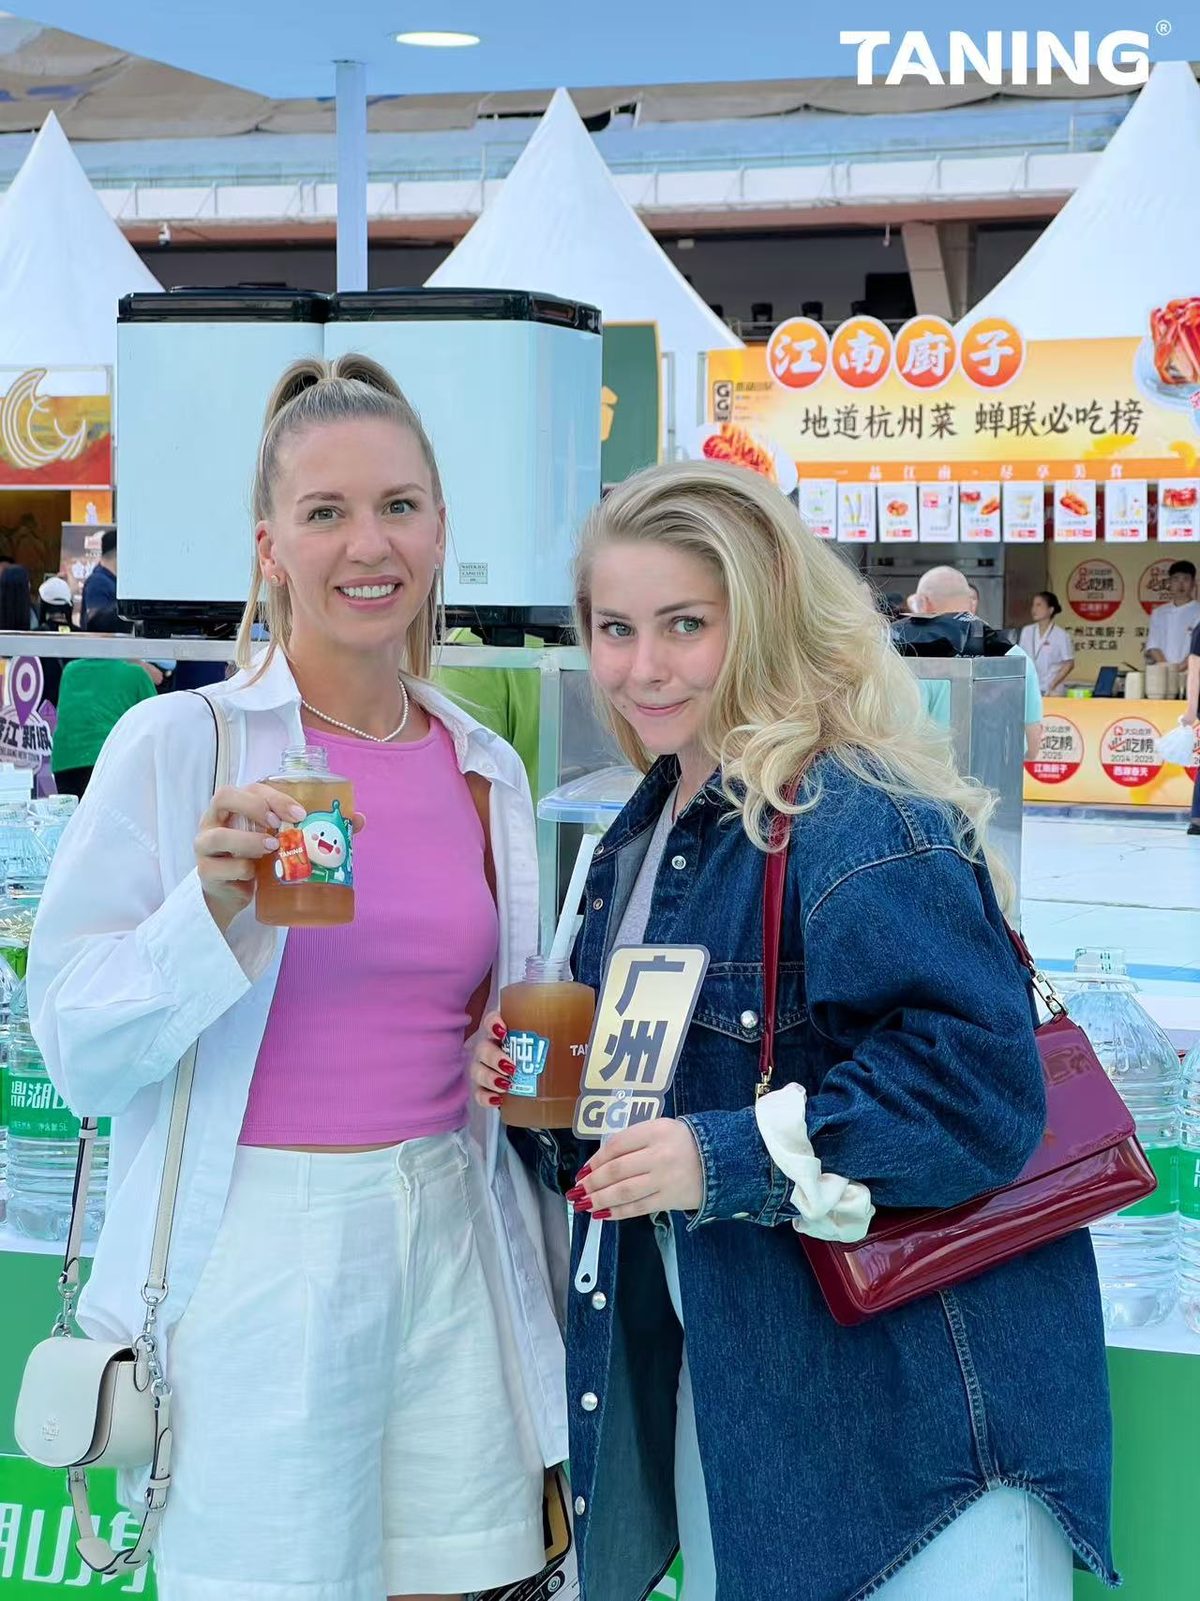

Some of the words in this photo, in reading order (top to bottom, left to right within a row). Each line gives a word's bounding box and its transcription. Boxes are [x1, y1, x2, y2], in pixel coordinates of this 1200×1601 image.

[774, 329, 1014, 377] 江南厨子
[800, 404, 958, 440] 地道杭州菜
[974, 398, 1144, 438] 蝉联必吃榜
[1108, 737, 1155, 753] 必吃榜
[598, 955, 686, 1084] 广州
